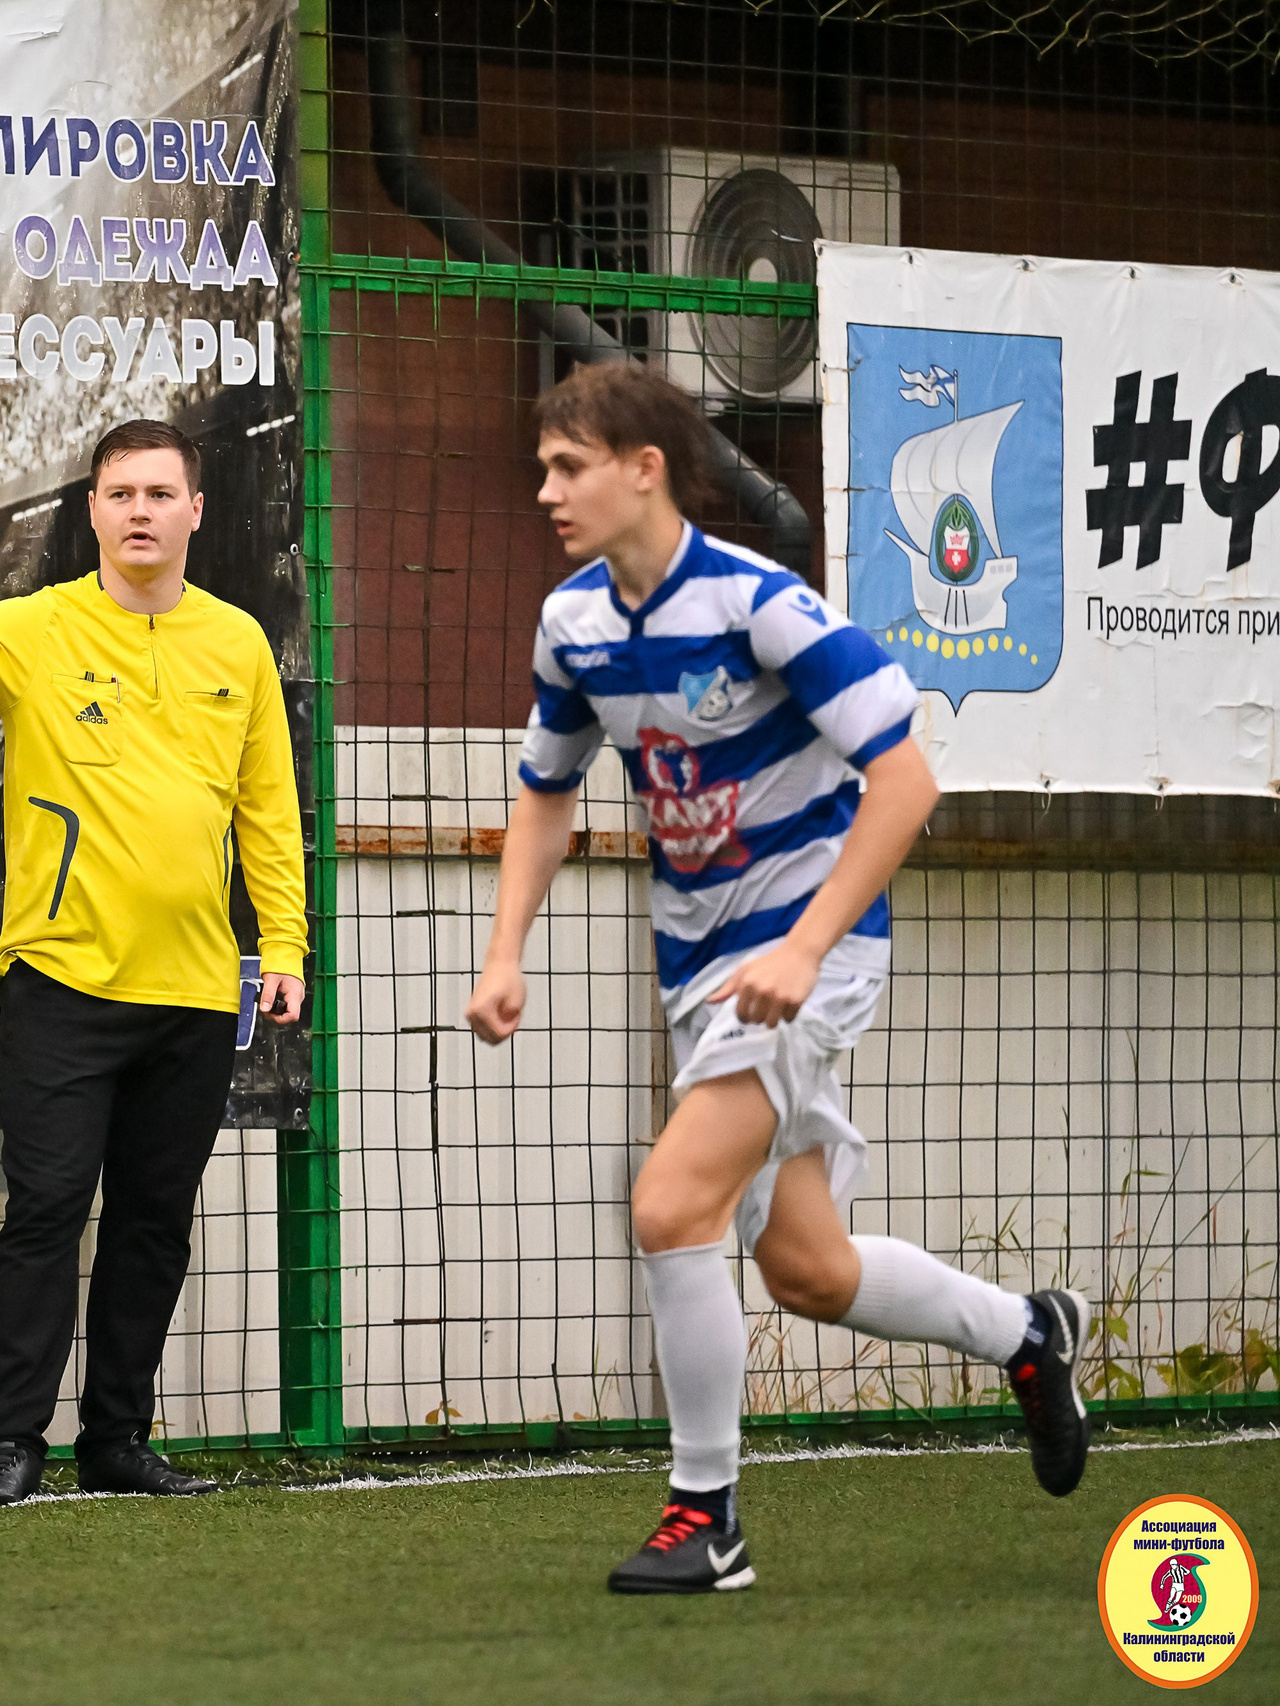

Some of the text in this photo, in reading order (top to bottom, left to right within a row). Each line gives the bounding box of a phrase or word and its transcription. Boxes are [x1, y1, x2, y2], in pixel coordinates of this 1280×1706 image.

[13, 211, 279, 292] ОДЕЖДА
[1087, 596, 1280, 644] Проводится при
[75, 714, 109, 725] adidas
